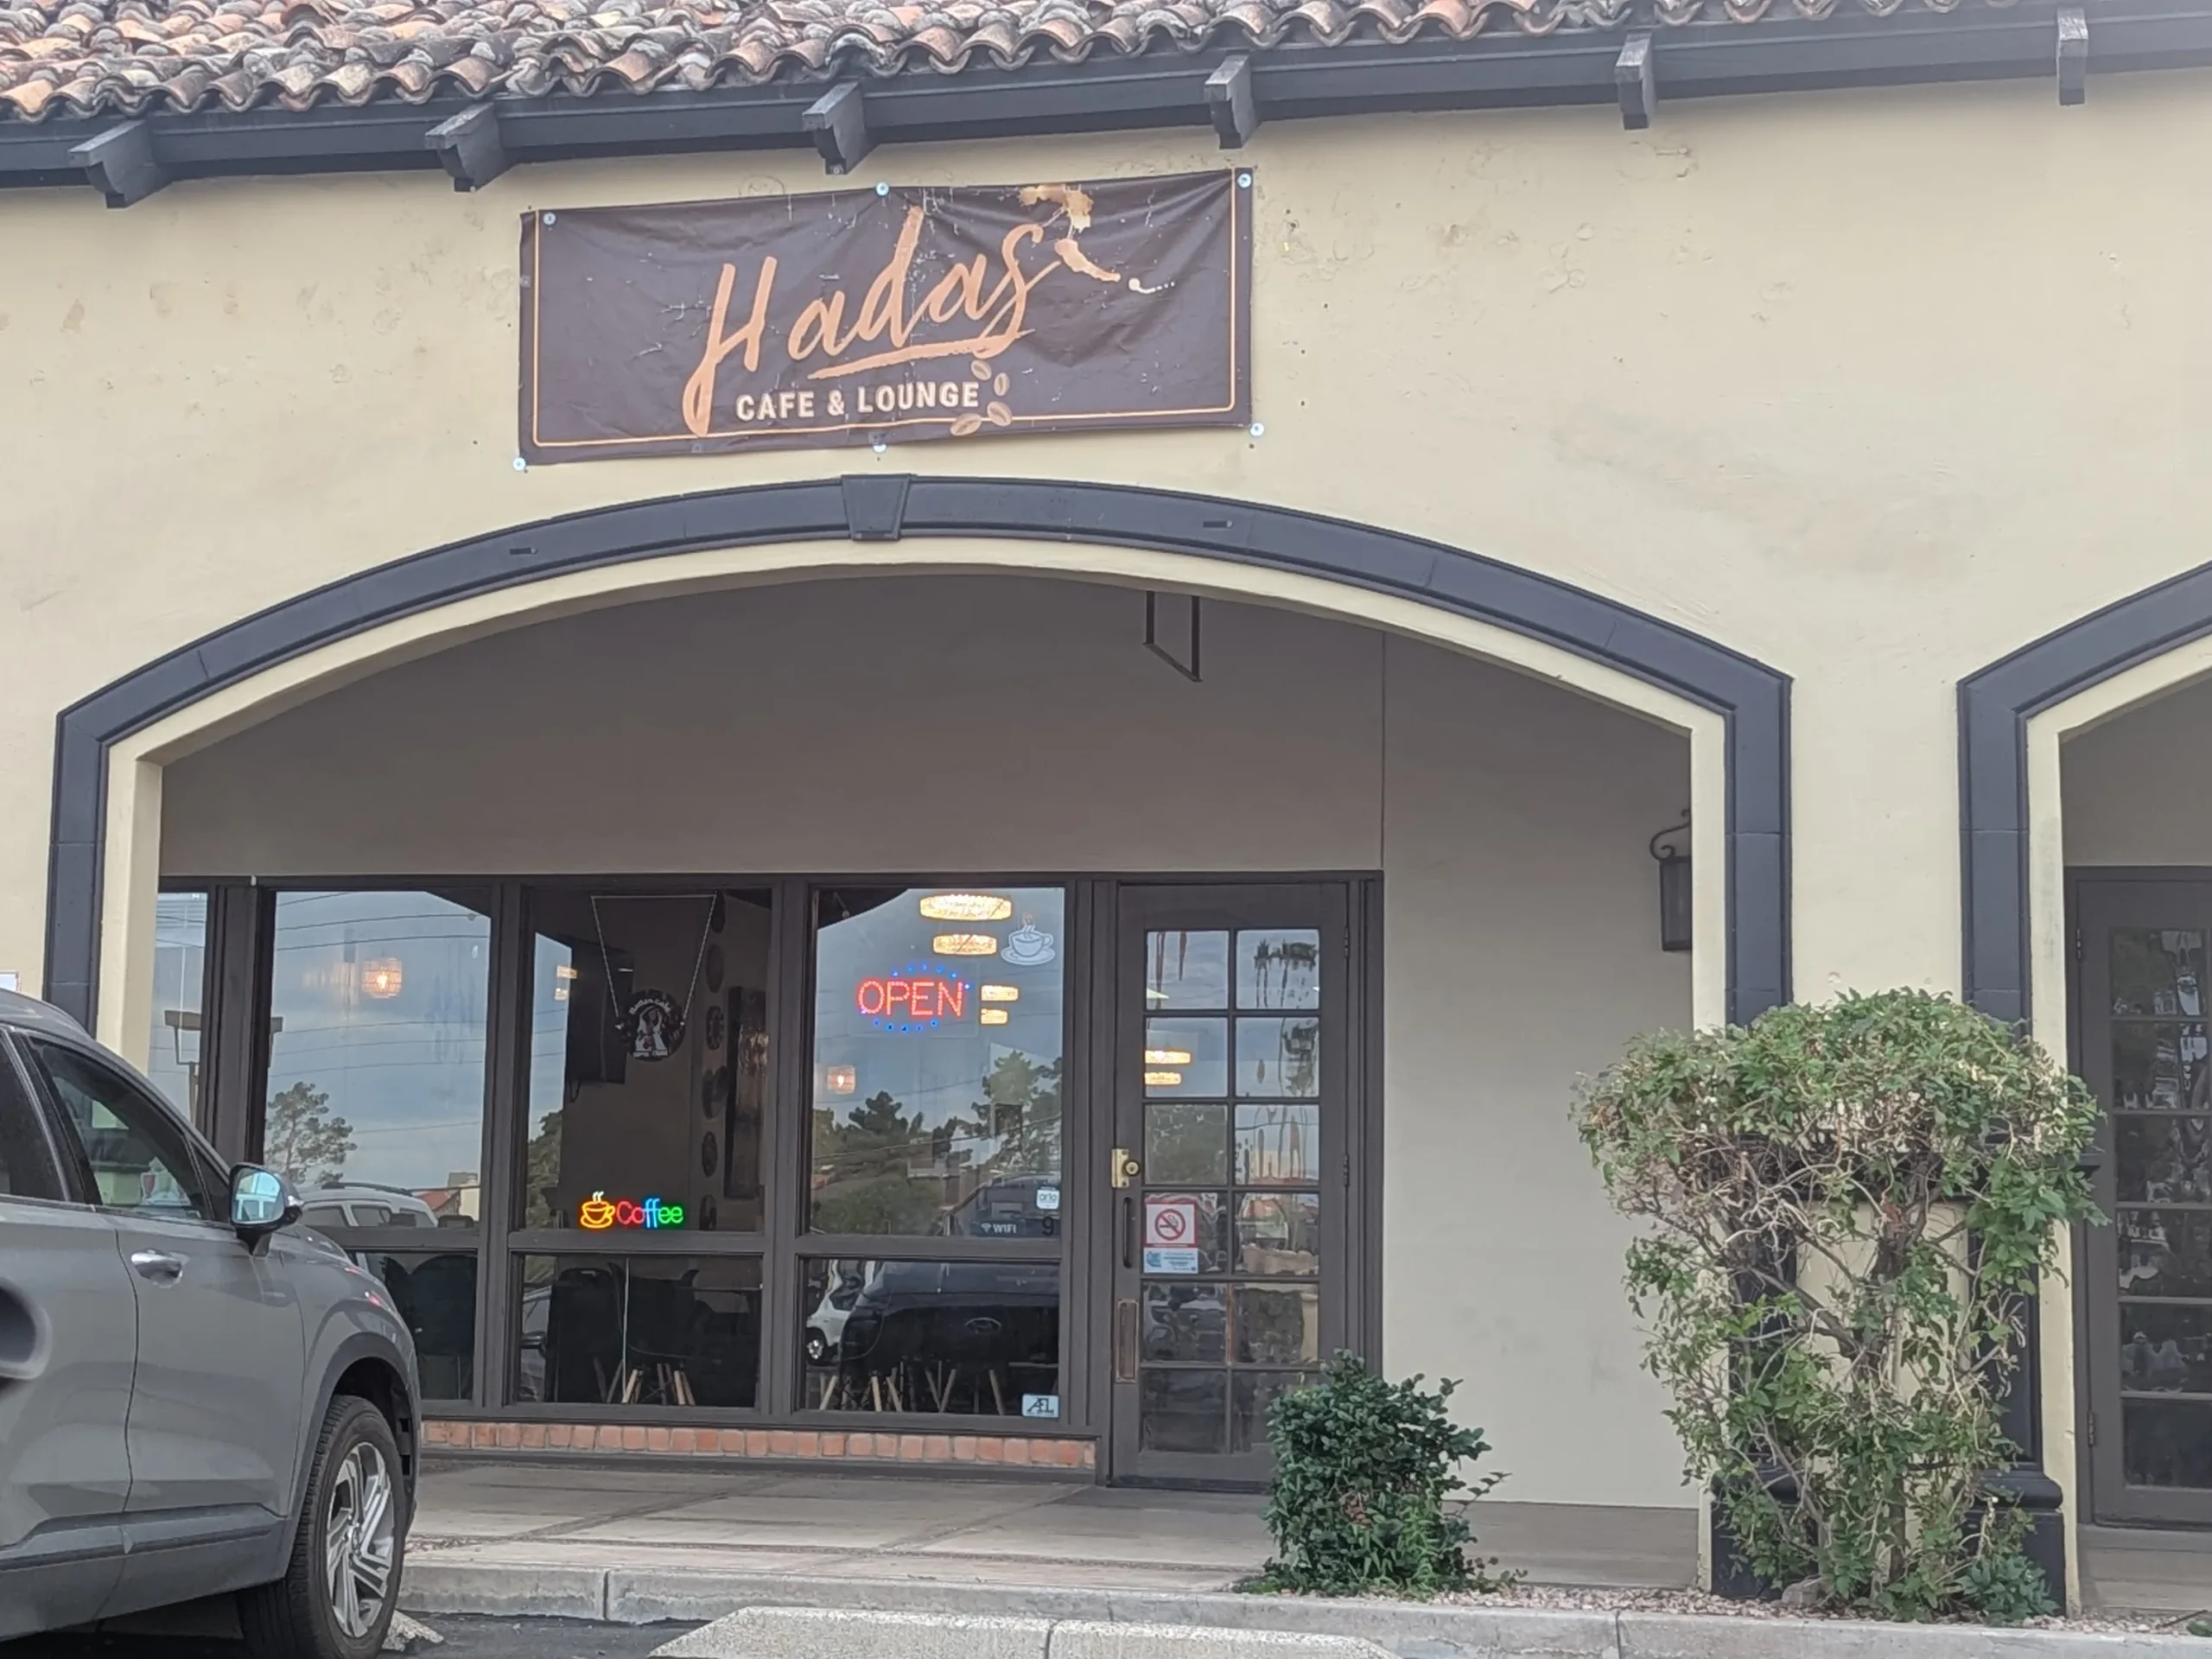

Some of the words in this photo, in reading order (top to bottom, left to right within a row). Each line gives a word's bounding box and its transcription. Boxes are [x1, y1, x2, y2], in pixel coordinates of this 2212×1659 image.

[683, 206, 1061, 436] Hadas
[736, 391, 815, 422] CAFE
[827, 390, 845, 416] &
[858, 382, 980, 413] LOUNGE
[858, 981, 963, 1016] OPEN
[616, 1198, 683, 1228] Coffee
